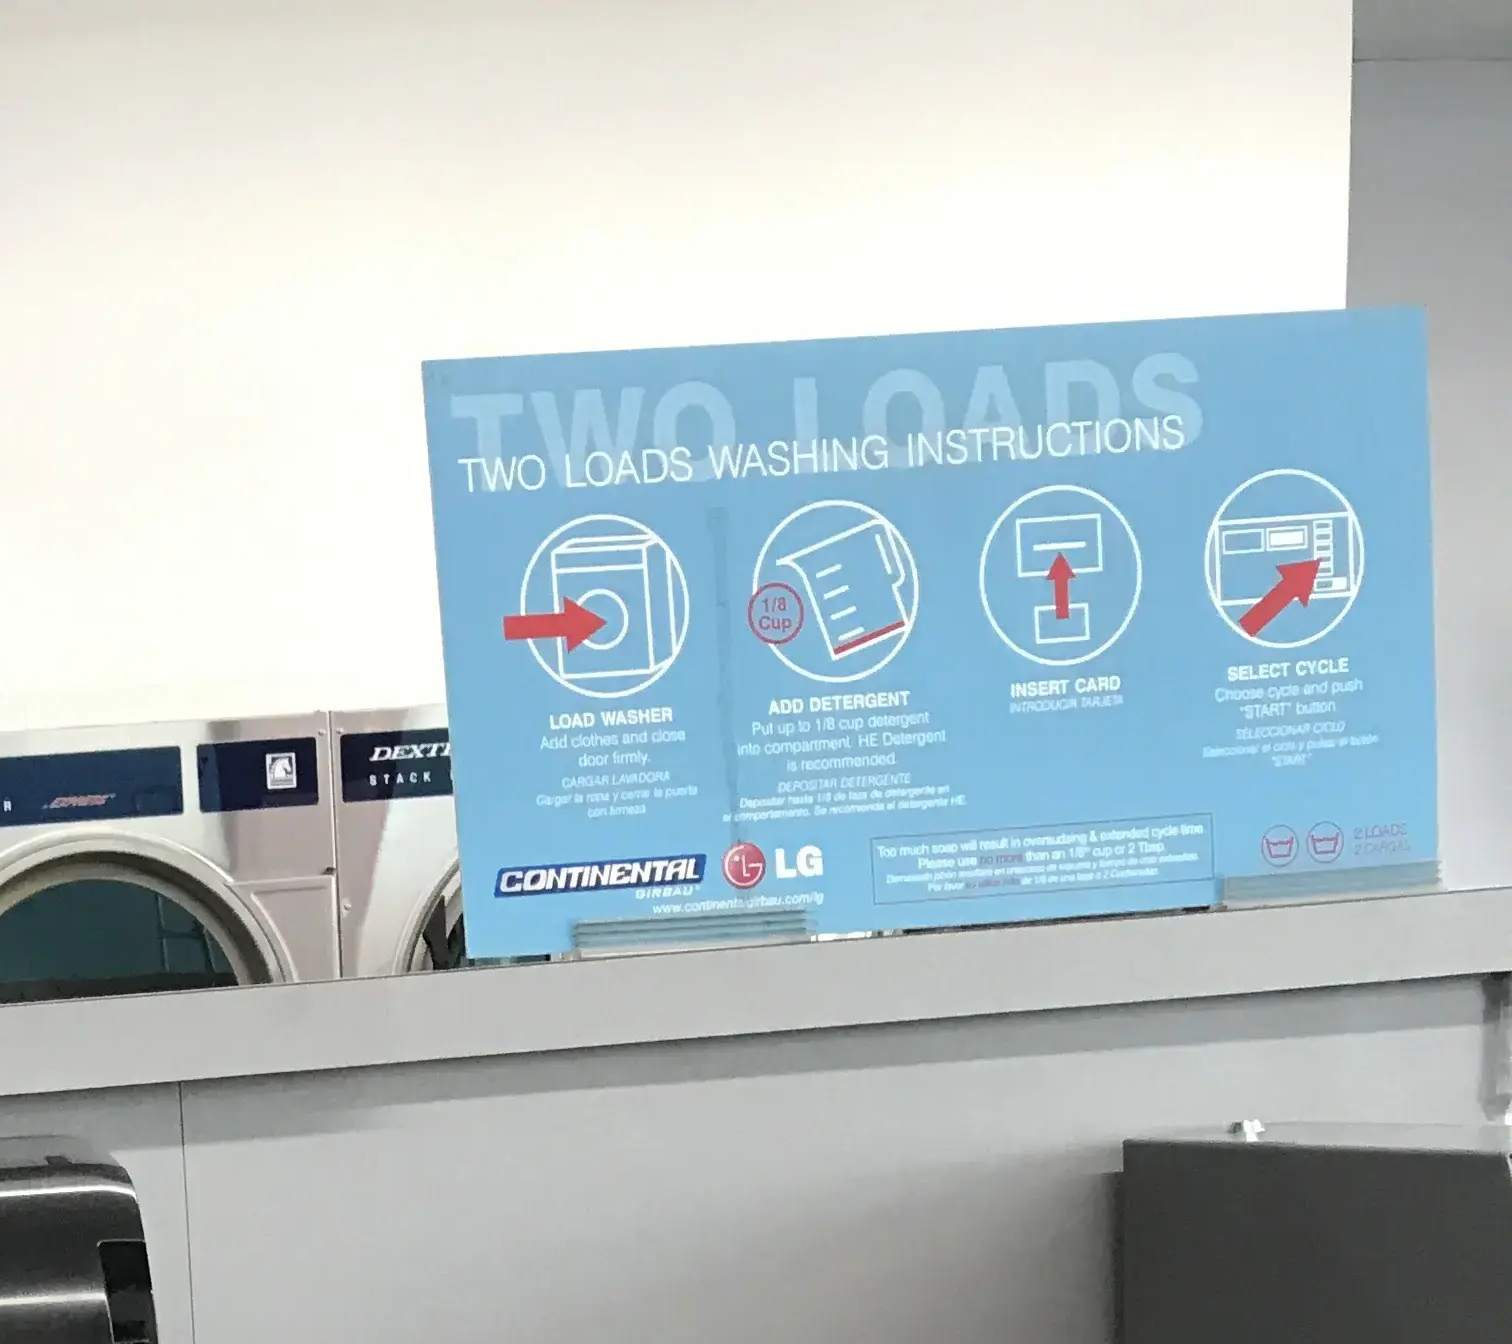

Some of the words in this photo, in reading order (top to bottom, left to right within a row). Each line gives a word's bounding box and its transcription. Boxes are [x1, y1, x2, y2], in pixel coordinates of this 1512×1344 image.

[451, 380, 736, 493] TWO
[793, 352, 1203, 473] LOADS
[458, 455, 545, 493] TWO
[565, 447, 692, 488] LOADS
[707, 435, 888, 480] WASHING
[907, 414, 1184, 468] INSTRUCTIONS
[762, 597, 787, 612] 1/8
[759, 615, 792, 632] Cup
[1228, 662, 1290, 681] SELECT
[1296, 657, 1348, 676] CYCLE
[1011, 679, 1070, 698] INSERT
[1075, 676, 1120, 693] CARD
[1215, 687, 1264, 702] Choose
[1268, 684, 1299, 699] cycle
[1304, 681, 1328, 694] and
[1332, 678, 1363, 695] push
[769, 698, 804, 716] ADD
[809, 690, 910, 713] DETERGENT
[549, 712, 595, 729] LOAD
[601, 707, 673, 726] WASHER
[752, 721, 773, 736] Put
[778, 720, 795, 736] up
[798, 719, 811, 733] to
[816, 717, 835, 733] 1/8
[839, 717, 863, 732] cup
[867, 711, 930, 730] detergent
[540, 735, 567, 749] Add
[571, 733, 618, 748] clothes
[622, 731, 648, 744] and
[651, 729, 686, 743] close
[738, 742, 760, 756] into
[858, 734, 878, 748] HE
[883, 729, 946, 748] Detergent
[578, 753, 609, 767] door
[612, 750, 651, 766] firmly.
[787, 759, 797, 772] is
[369, 771, 431, 786] STACK
[877, 845, 896, 858] Too
[900, 844, 930, 855] much
[1089, 830, 1098, 842] &
[1354, 827, 1364, 840] 2
[1128, 843, 1136, 855] 2
[775, 845, 823, 879] LG
[500, 857, 699, 893] CONTINENTAL
